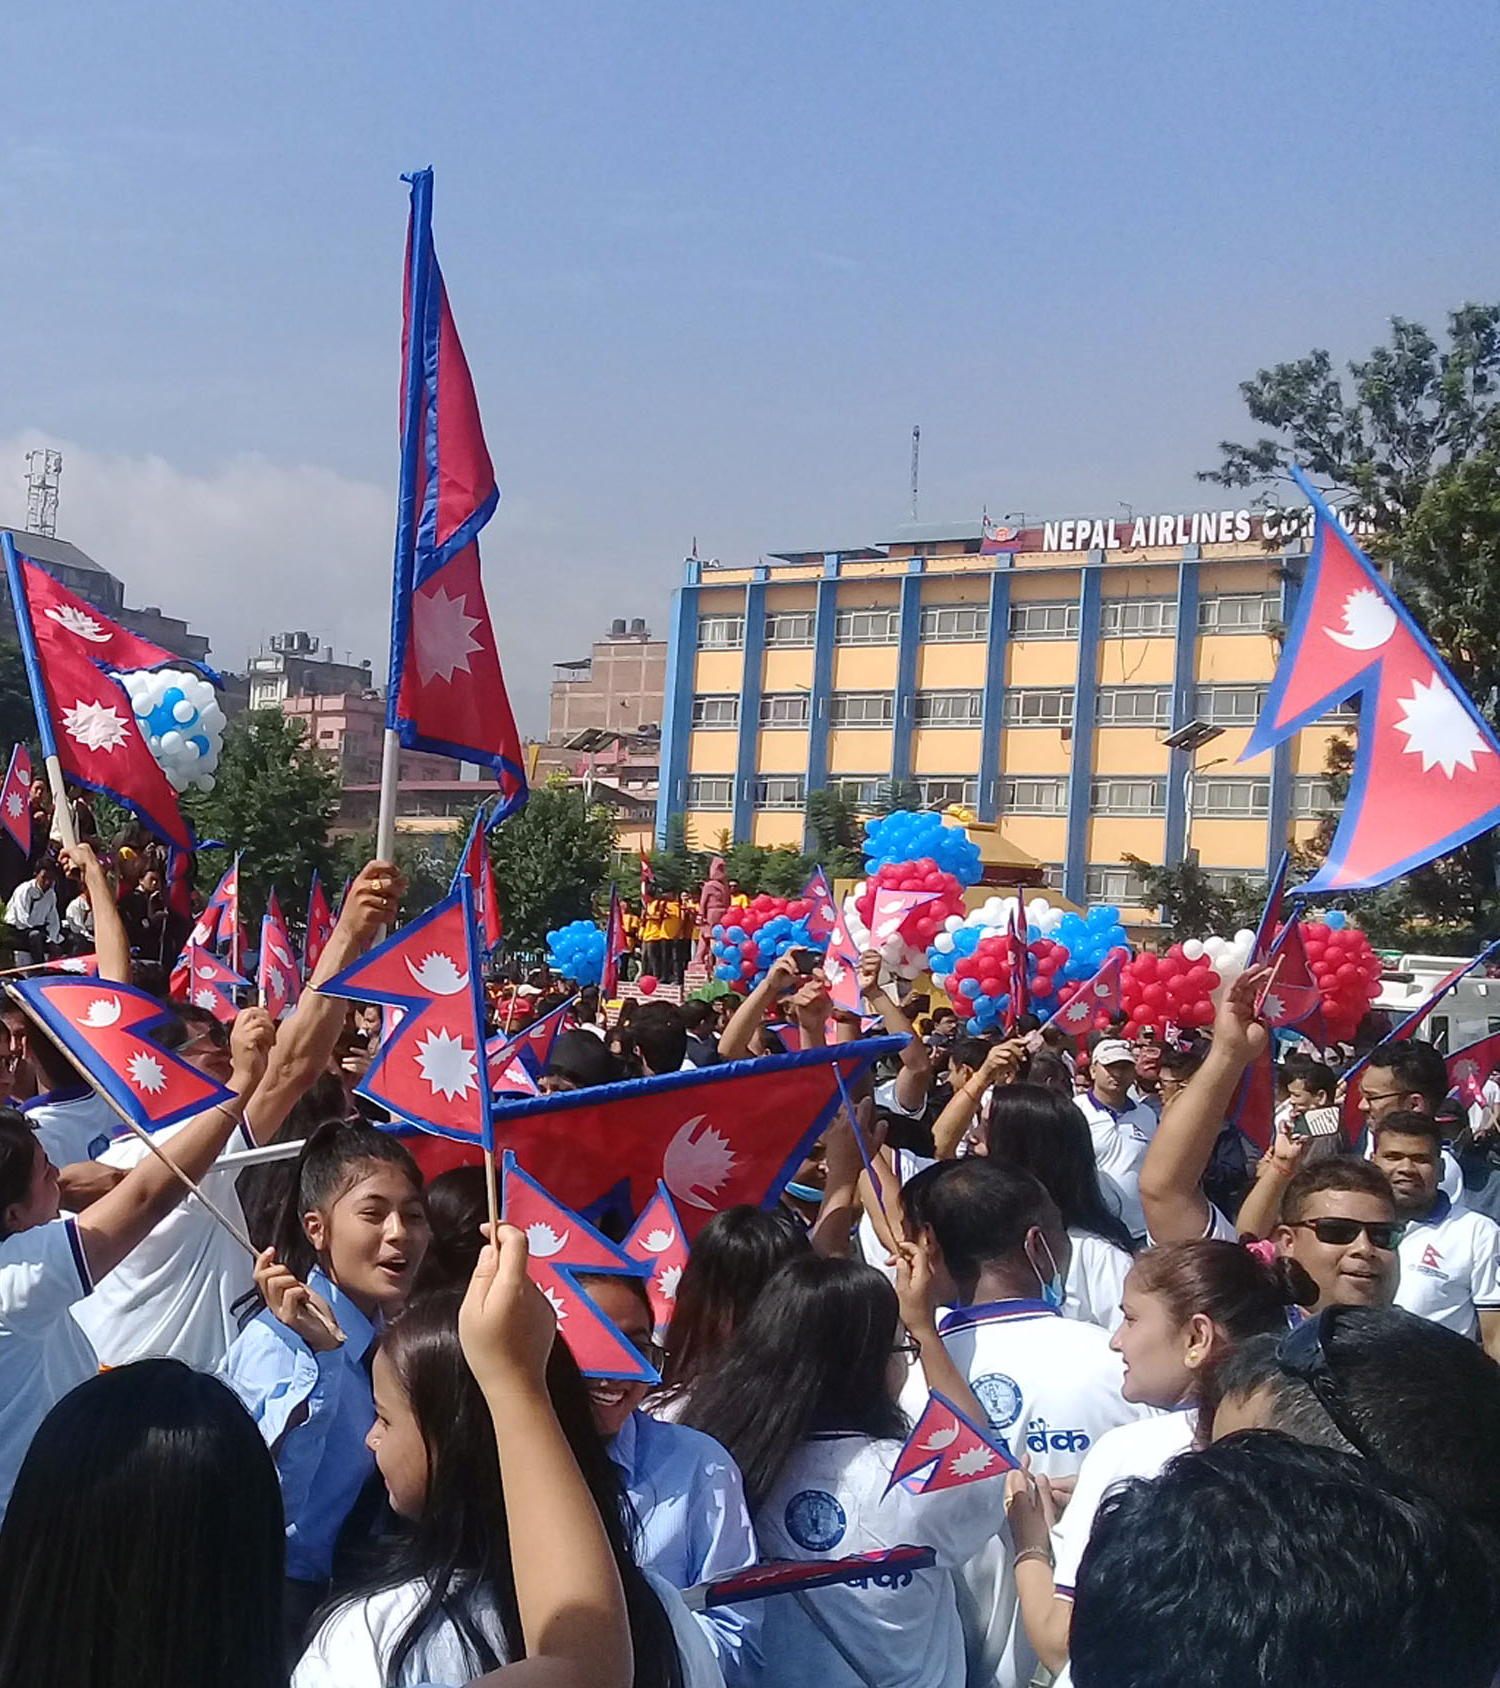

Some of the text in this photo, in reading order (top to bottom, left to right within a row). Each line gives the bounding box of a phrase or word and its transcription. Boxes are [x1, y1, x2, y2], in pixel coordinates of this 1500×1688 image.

[1043, 517, 1120, 551] NEPAL
[1130, 509, 1251, 548] AIRLINES
[1026, 1417, 1091, 1454] बैंक
